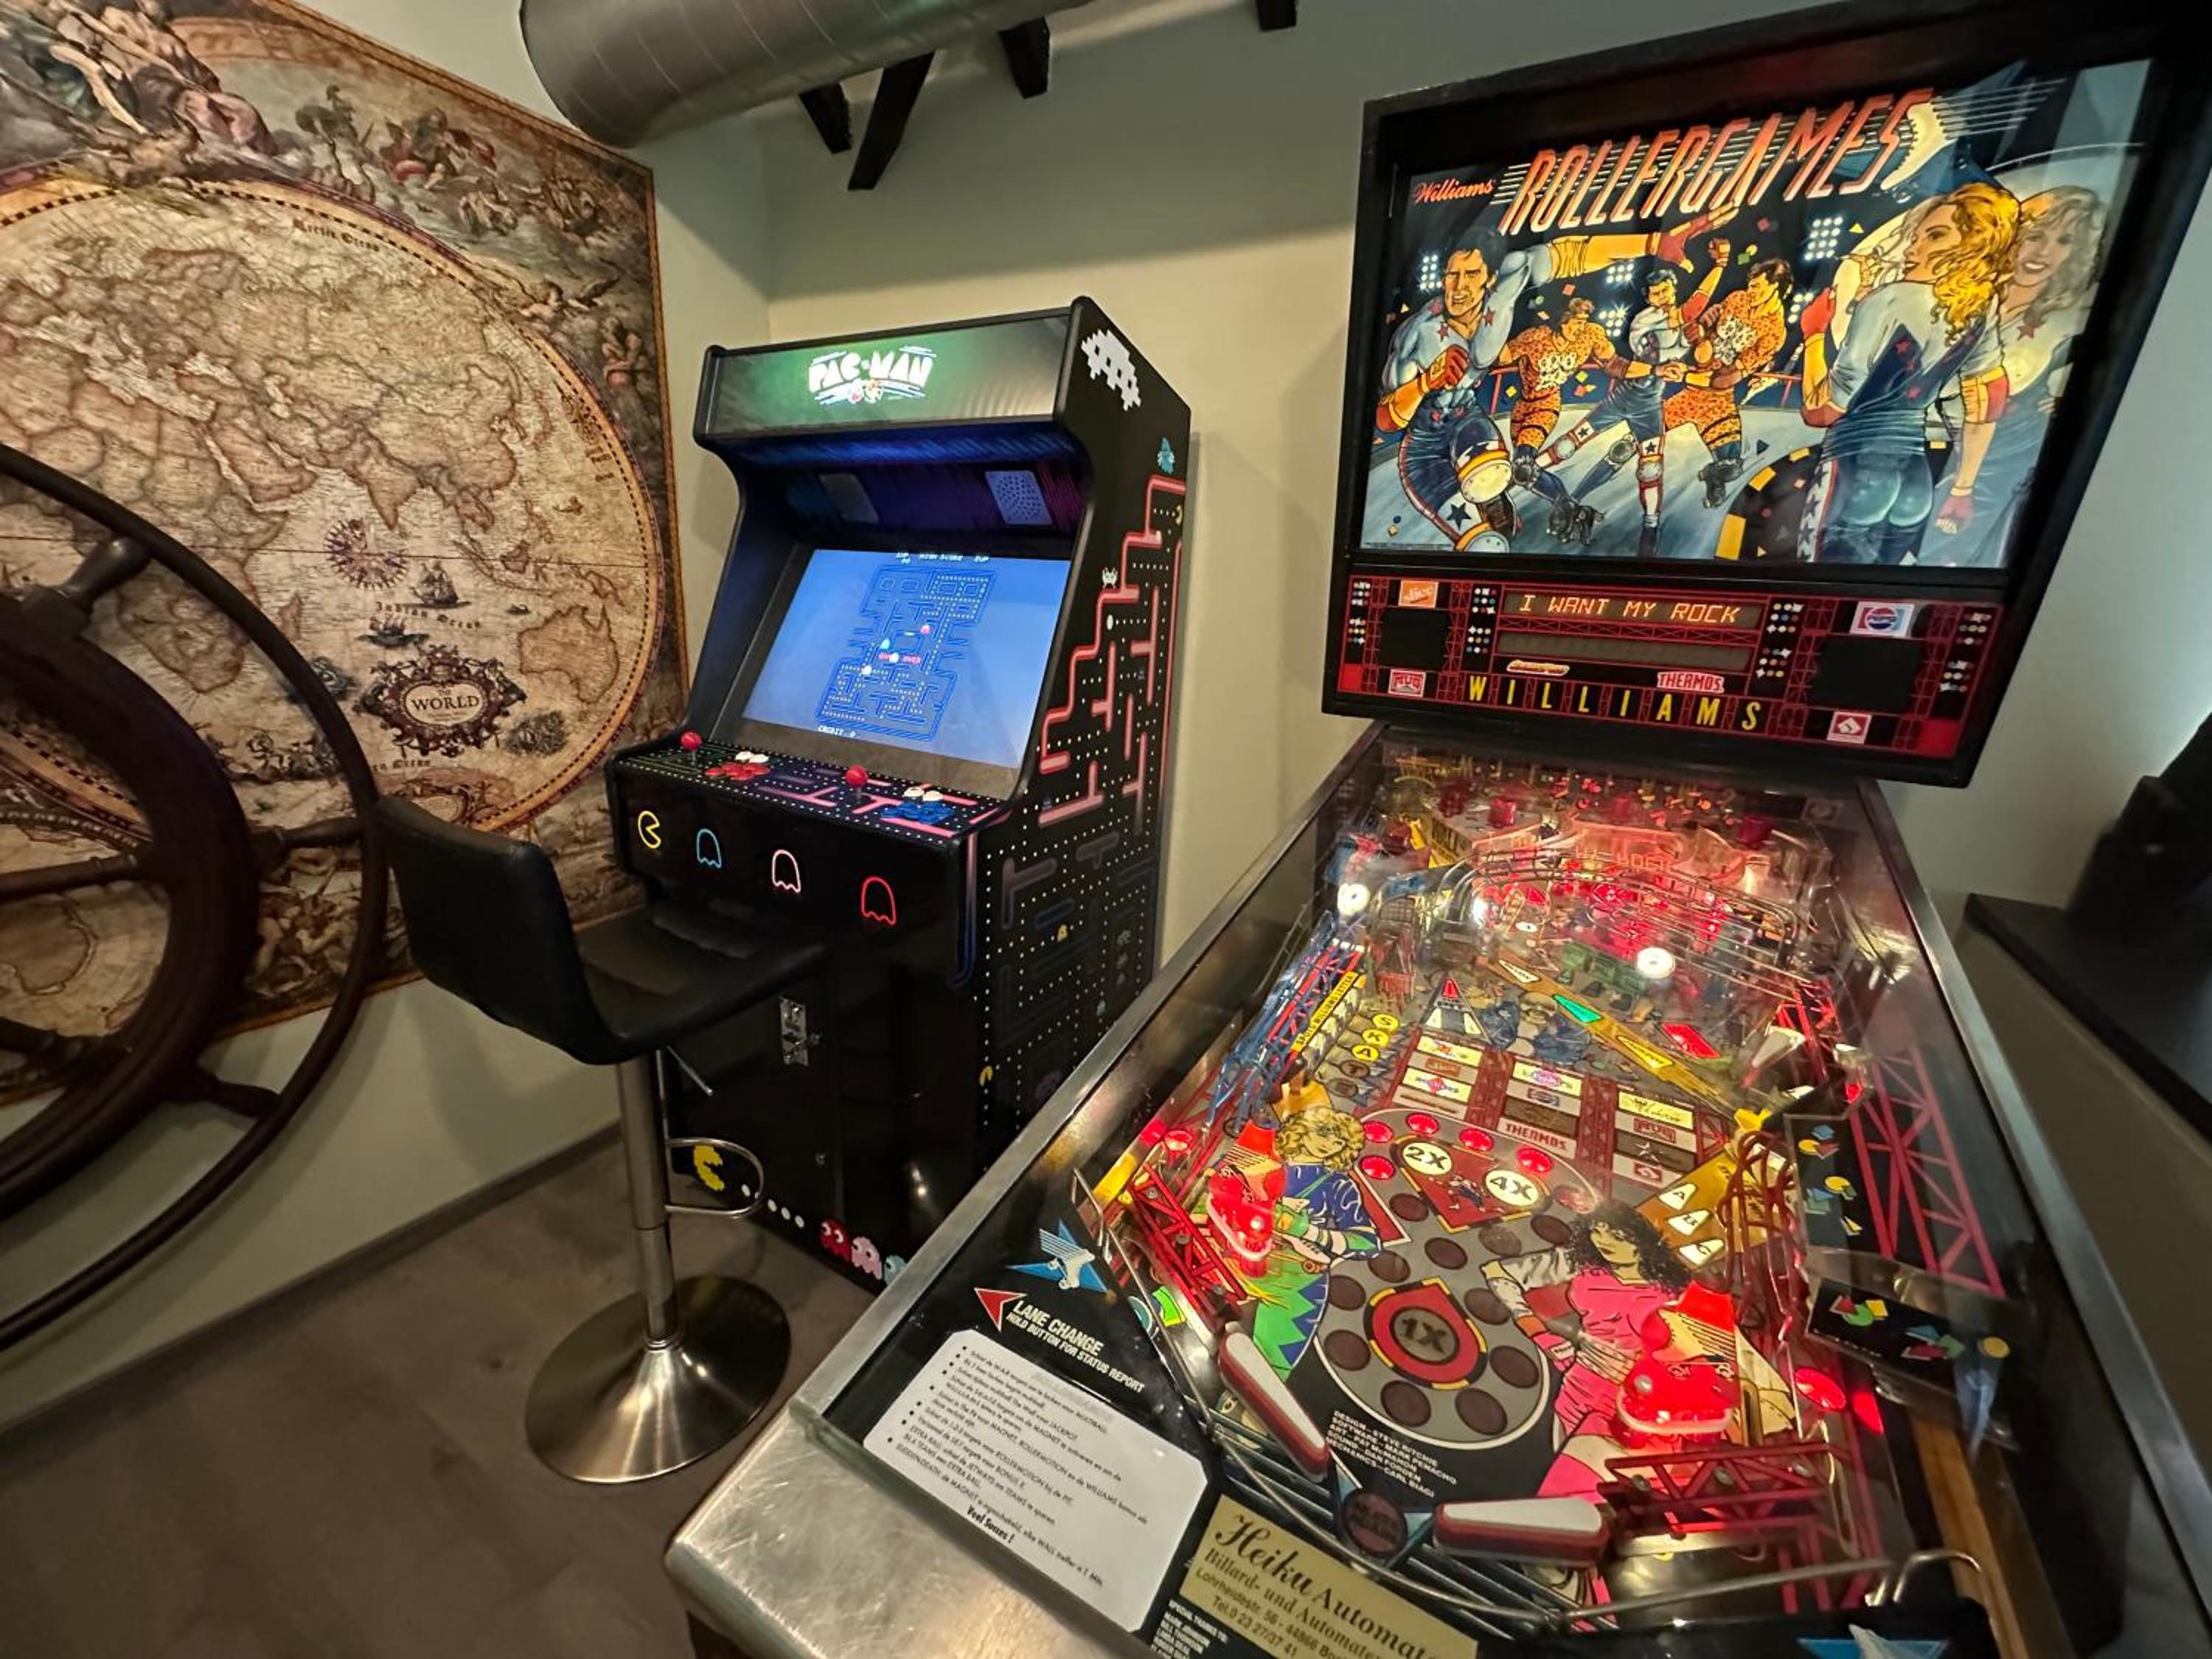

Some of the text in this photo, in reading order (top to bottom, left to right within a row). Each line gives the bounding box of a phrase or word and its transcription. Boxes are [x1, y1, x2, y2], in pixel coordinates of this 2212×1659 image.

[1414, 89, 1934, 236] Williams ROLLERGAMES
[809, 349, 933, 393] PAC-MAN
[1519, 594, 1742, 624] I WANT MY ROCK
[411, 695, 480, 712] WORLD
[1505, 1122, 1568, 1151] THERMOS
[1406, 1145, 1448, 1170] 2X
[1489, 1176, 1532, 1201] 4X
[1012, 1300, 1105, 1357] LANE CHANGE
[1402, 1318, 1447, 1354] 1X
[1006, 1312, 1145, 1393] HOLD BUTTON FOR STATUS REPORT
[1327, 1430, 1422, 1482] SOUND DAN FORDEN
[1332, 1416, 1457, 1485] SOFTWARE MARK PENACHO
[1334, 1411, 1439, 1467] DESIGN STEVE RITCHIE
[1354, 1436, 1369, 1447] PAT
[1384, 1467, 1408, 1484] CARL
[1408, 1480, 1435, 1498] BIAGI
[965, 1504, 987, 1524] Veel
[1205, 1548, 1381, 1659] Billard- und Automate
[1215, 1514, 1313, 1596] Heiku
[1312, 1587, 1439, 1659] Automat
